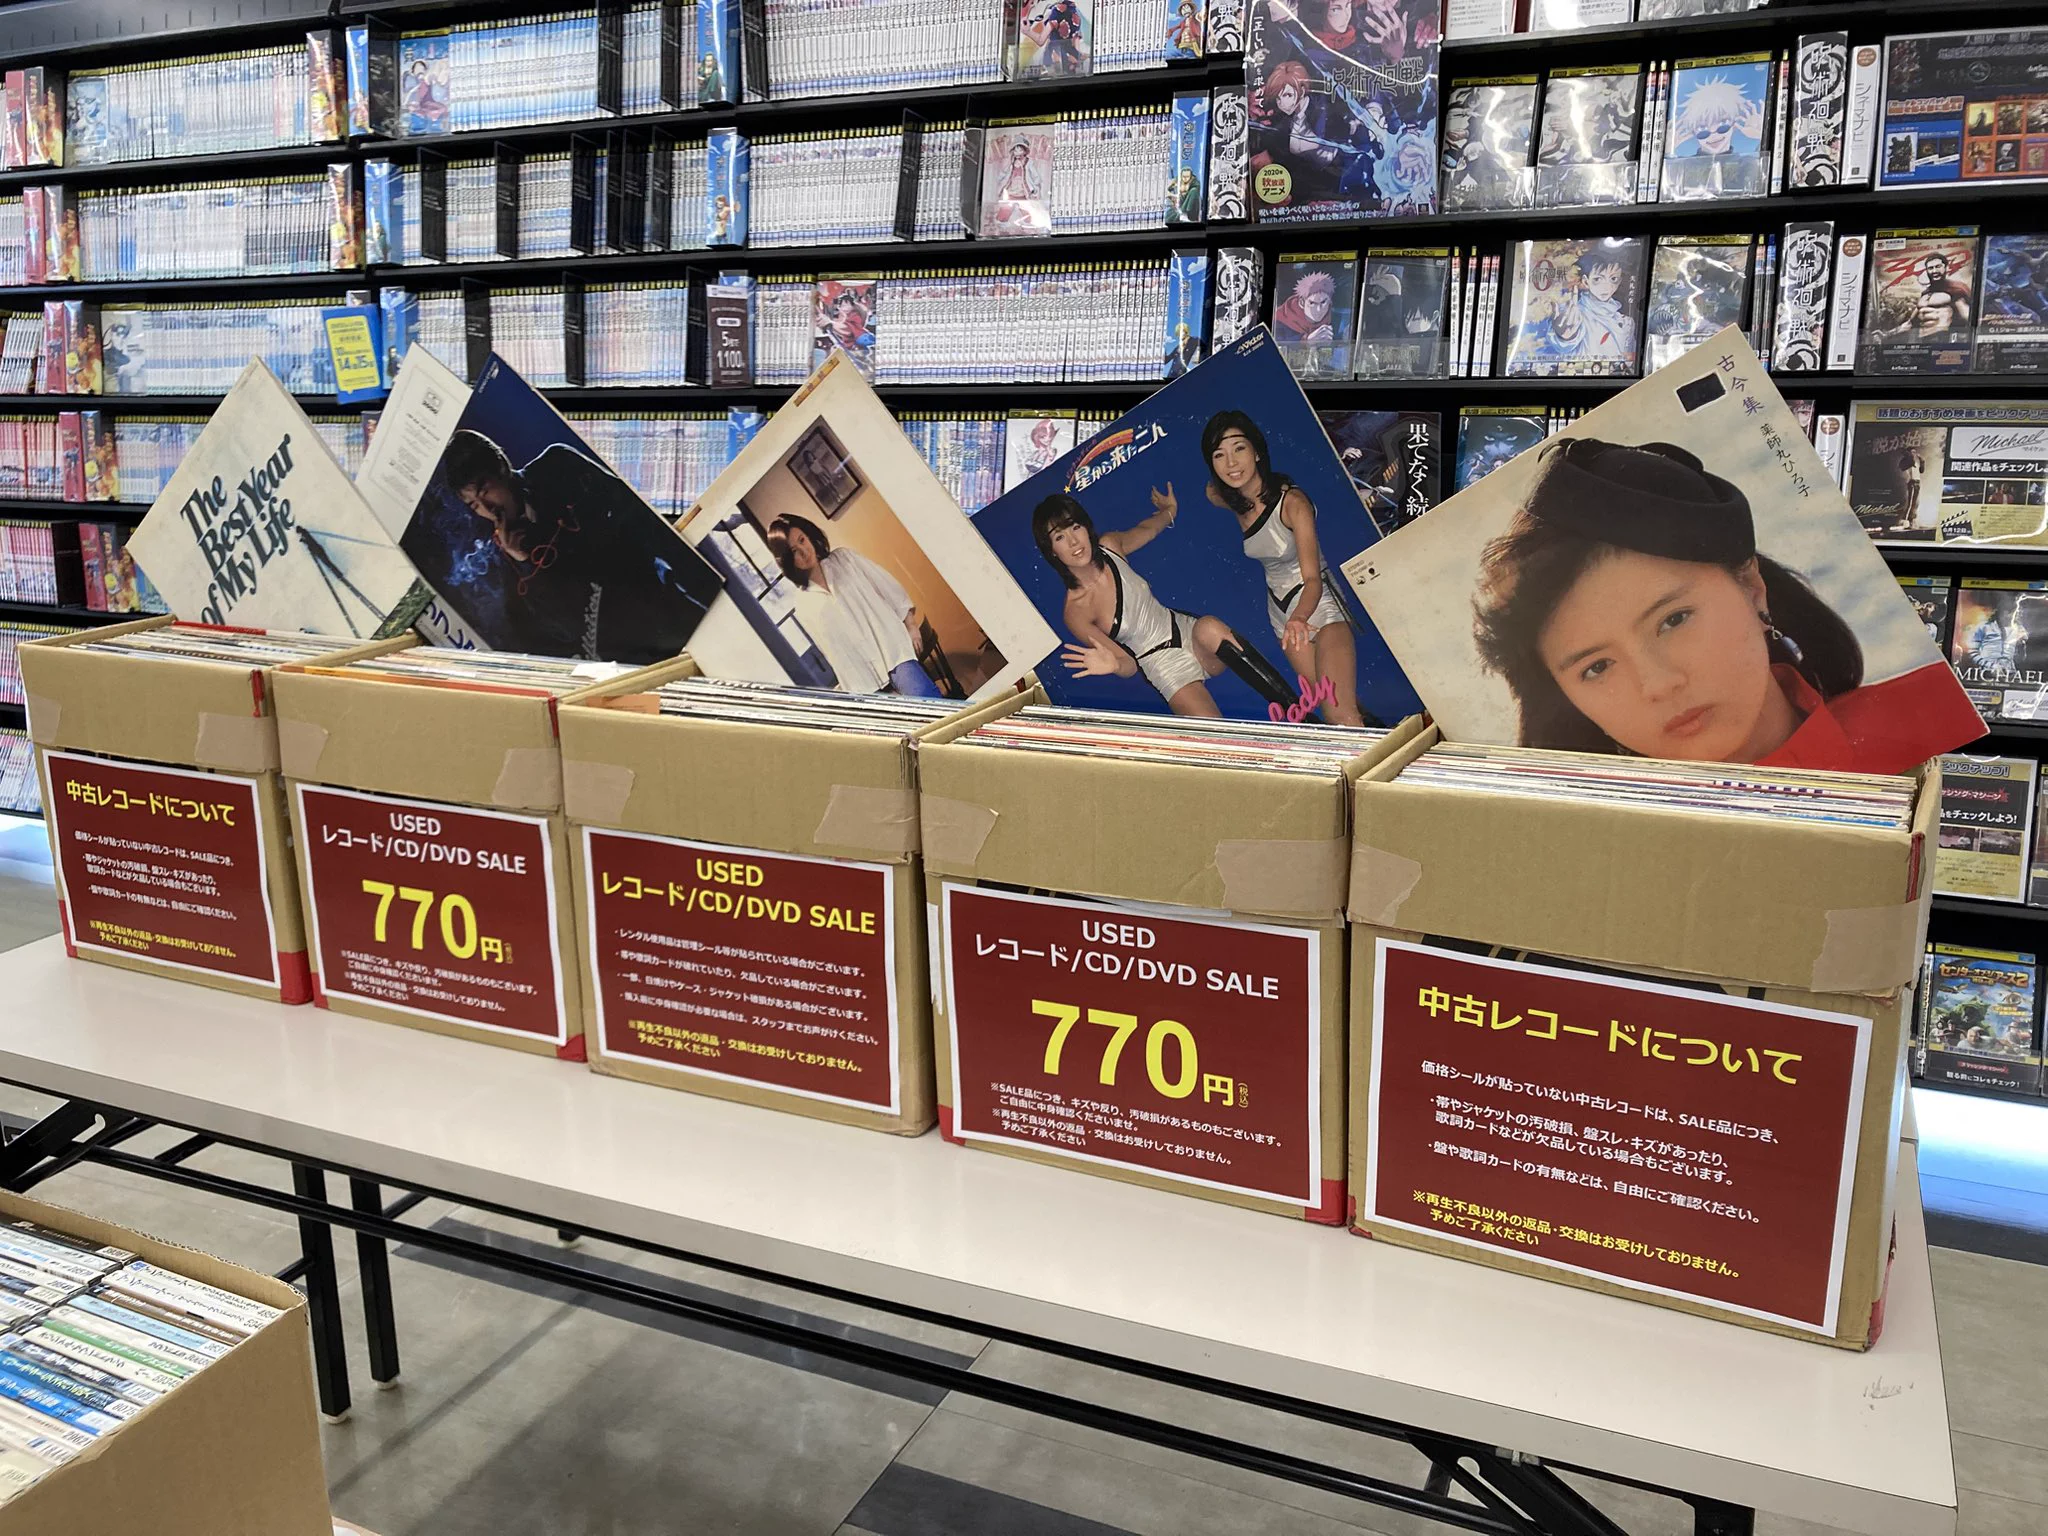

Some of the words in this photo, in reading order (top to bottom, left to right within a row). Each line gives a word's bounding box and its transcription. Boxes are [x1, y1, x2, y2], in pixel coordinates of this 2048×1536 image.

[1806, 42, 1833, 153] 呪術廻戦
[1262, 187, 1286, 197] アニメ
[1242, 331, 1264, 349] Victor
[1716, 353, 1765, 416] 古今集
[1759, 422, 1811, 498] 薬師丸ひろ子
[1970, 429, 2048, 457] Michael
[179, 474, 228, 545] The
[198, 494, 251, 578] Best
[236, 432, 295, 517] Year
[246, 496, 296, 569] Life
[201, 581, 226, 626] of
[213, 550, 259, 613] My
[66, 778, 236, 827] 中古レコードについて
[389, 811, 442, 837] USED
[322, 823, 472, 868] レコード/CD/DVD
[476, 849, 528, 876] SALE
[695, 857, 764, 888] USED
[361, 878, 505, 965] 770円
[601, 871, 802, 924] レコード/CD/DVD
[809, 904, 876, 935] SALE
[1081, 918, 1156, 950] USED
[974, 932, 1198, 987] レコード/CD/DVD
[1205, 968, 1280, 1001] SALE
[1030, 998, 1234, 1107] 770円
[1417, 985, 1804, 1086] 中古レコードについて
[990, 1081, 1283, 1149] ※SALE品につき、キズや反り、汚破損があるものもございます。
[999, 1095, 1140, 1132] ご自由に中身確認くださいませ。
[1001, 1119, 1087, 1147] 予めご了承ください
[1420, 1059, 1780, 1145] 価格シールが貼っていない中古レコードは、SALE品につき、
[991, 1107, 1232, 1166] ※再生不良以外の返品・交換はお受けしておりません。
[1434, 1110, 1734, 1187] 歌詞カードなどが欠品している場合もございます。
[1412, 1188, 1740, 1279] ※再生不良以外の返品・交換はお受けしておりません。
[1429, 1208, 1540, 1247] 予めご了承ください
